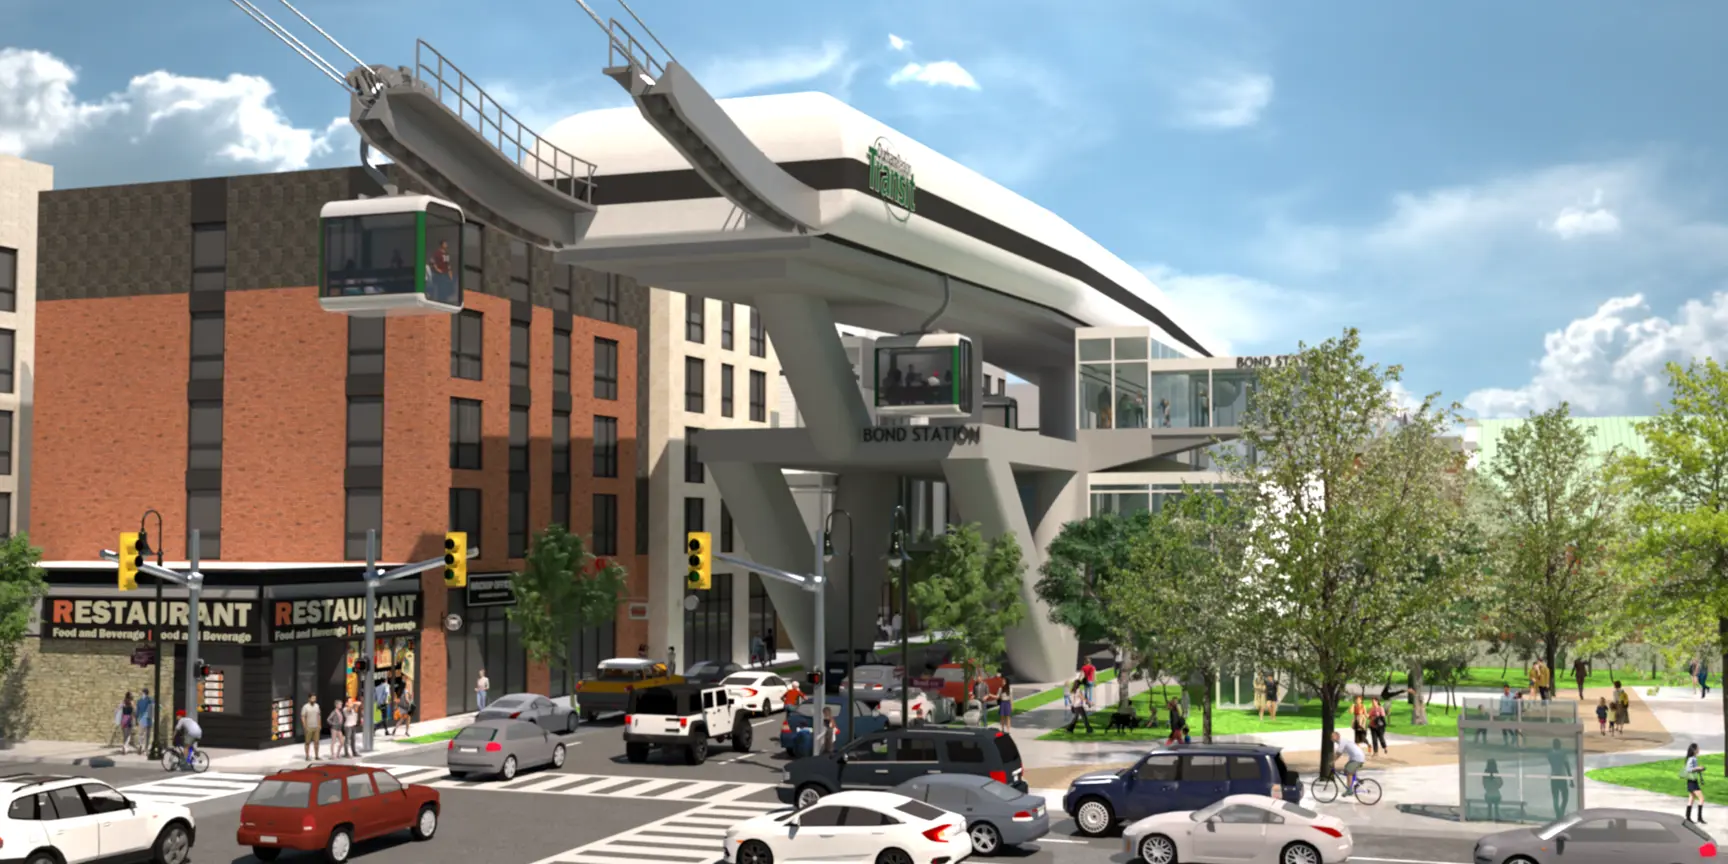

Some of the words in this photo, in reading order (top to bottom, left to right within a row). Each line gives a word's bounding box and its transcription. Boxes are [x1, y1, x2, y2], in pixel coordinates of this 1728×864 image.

[868, 146, 916, 212] Transit
[1236, 356, 1271, 369] BOND
[863, 427, 906, 443] BOND
[912, 426, 981, 445] STATION
[53, 599, 253, 627] RESTAURANT
[52, 627, 77, 638] Food
[78, 628, 98, 638] and
[98, 628, 146, 642] Beverage
[160, 630, 180, 640] ood
[202, 630, 252, 644] Beverage
